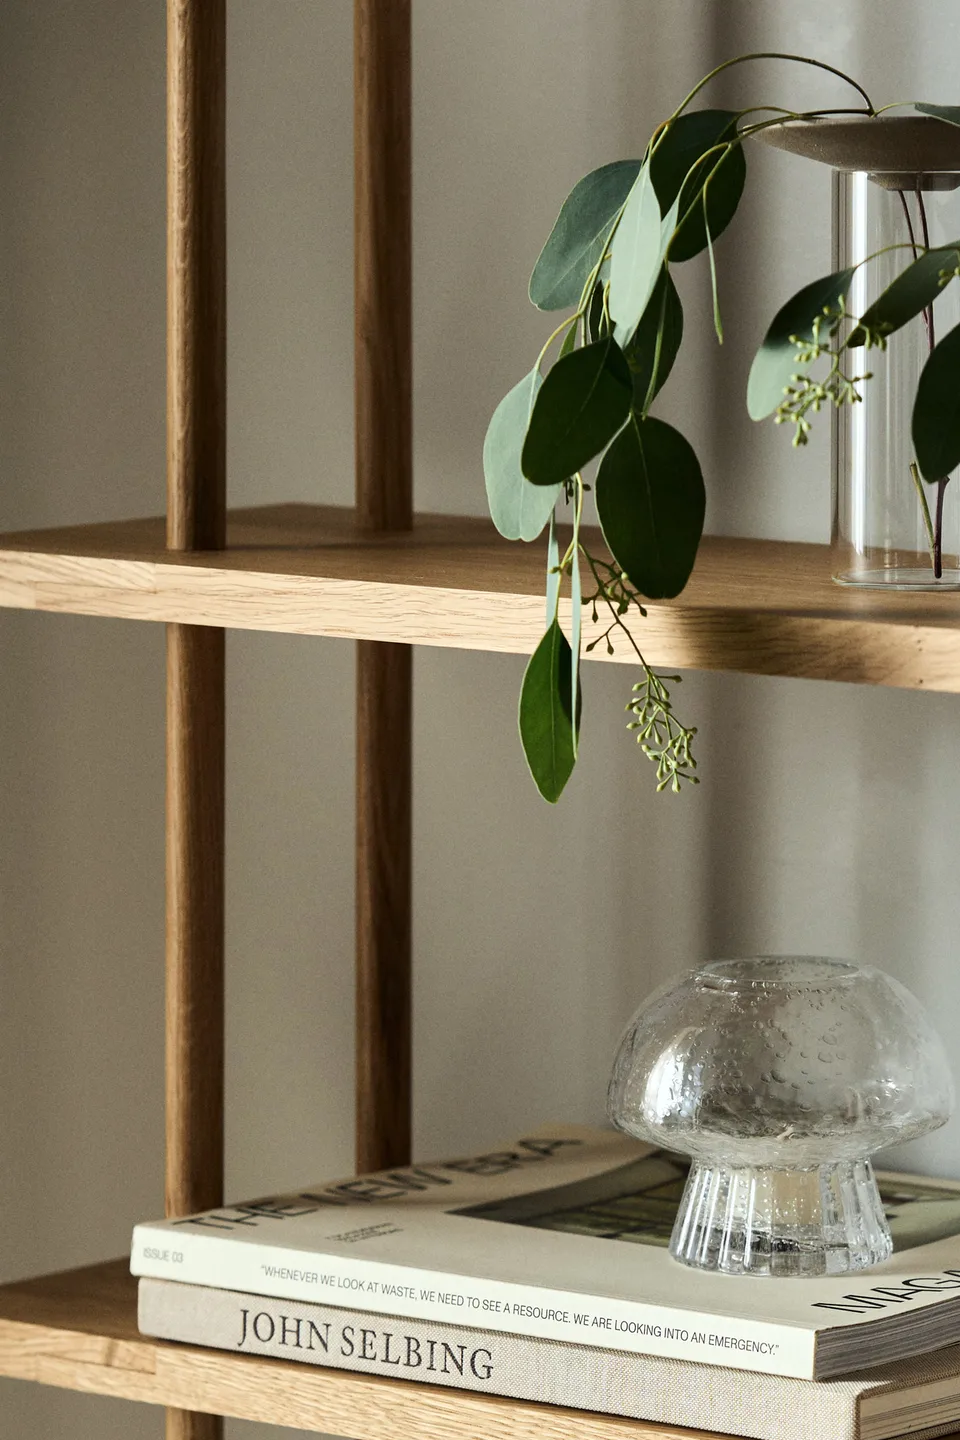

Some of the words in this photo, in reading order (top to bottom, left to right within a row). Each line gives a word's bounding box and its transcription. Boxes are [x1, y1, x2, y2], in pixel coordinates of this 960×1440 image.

[172, 1200, 318, 1230] THE
[299, 1168, 452, 1206] NEW
[447, 1137, 583, 1177] ERA
[143, 1248, 170, 1262] ISSUE
[171, 1251, 184, 1263] 03
[237, 1308, 332, 1354] JOHN
[340, 1325, 495, 1380] SELBING
[320, 1274, 336, 1287] WE
[337, 1277, 365, 1291] LOOK
[367, 1281, 380, 1293] AT
[381, 1283, 418, 1301] WASTE,
[420, 1289, 436, 1302] WE
[437, 1292, 465, 1306] NEED
[466, 1296, 480, 1309] TO
[482, 1299, 501, 1313] SEE
[503, 1302, 511, 1314] A
[512, 1304, 571, 1324] RESOURCE.
[573, 1313, 589, 1326] WE
[591, 1316, 612, 1330] ARE
[614, 1319, 662, 1338] LOOKING
[663, 1328, 689, 1342] INTO
[690, 1332, 706, 1345] AN
